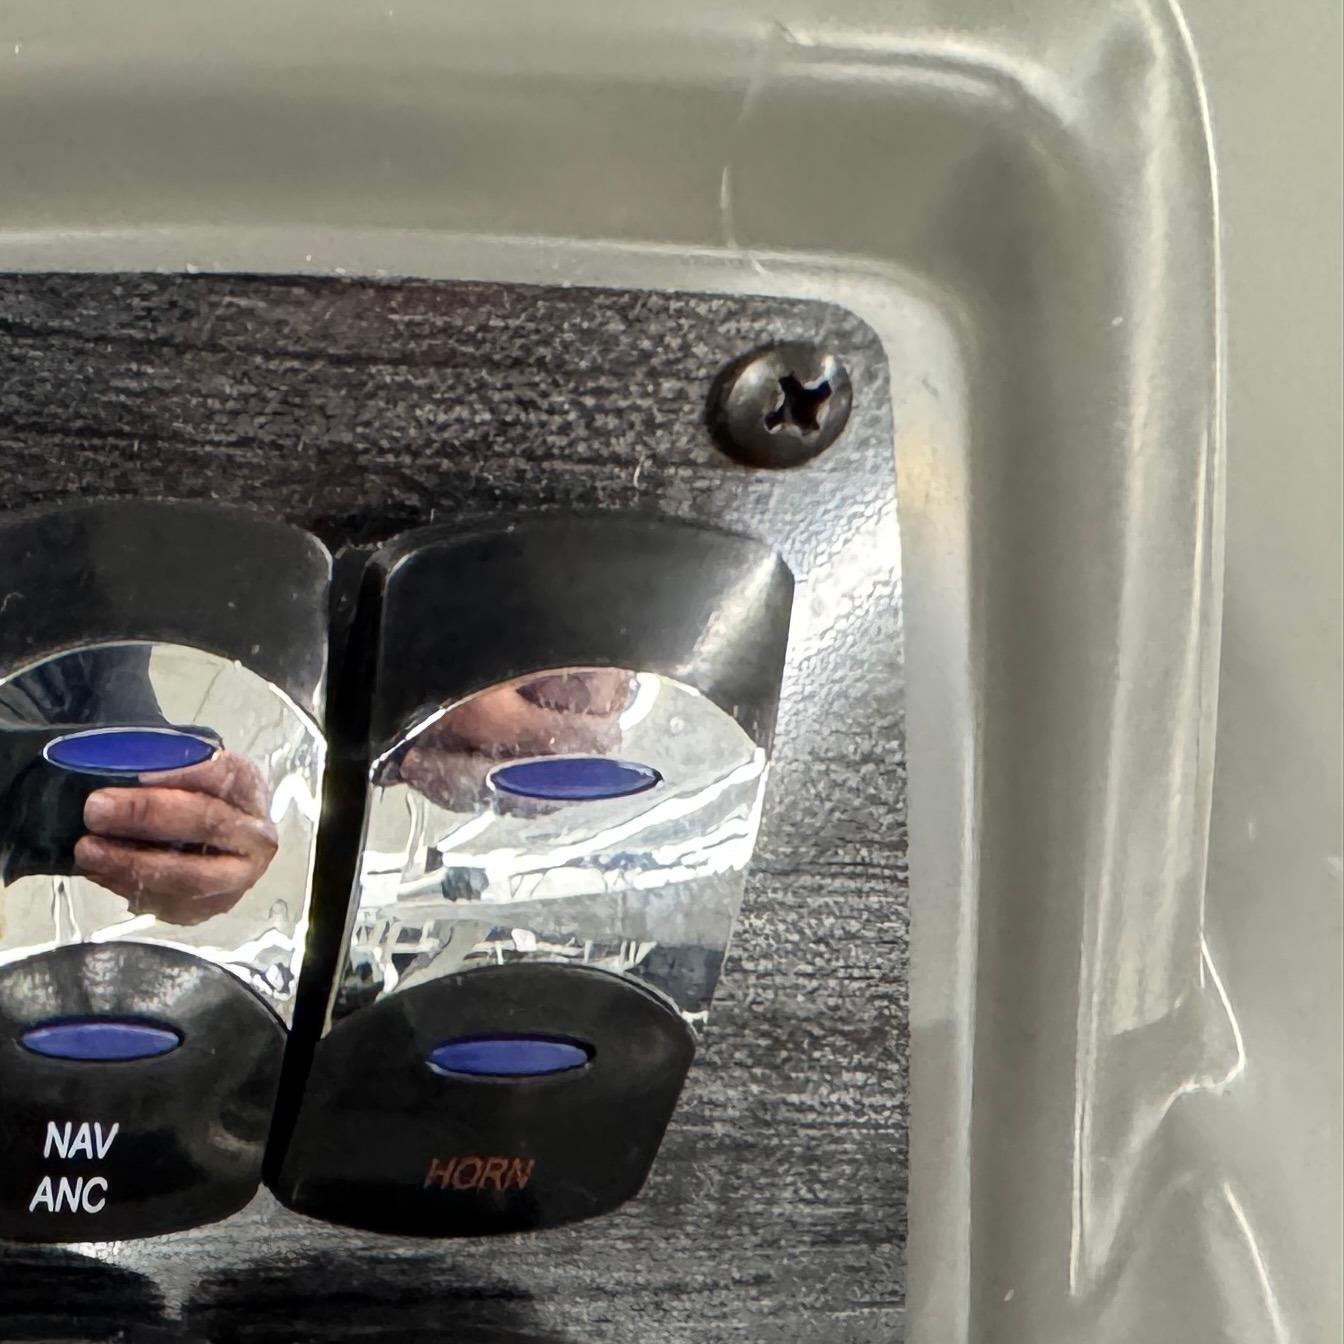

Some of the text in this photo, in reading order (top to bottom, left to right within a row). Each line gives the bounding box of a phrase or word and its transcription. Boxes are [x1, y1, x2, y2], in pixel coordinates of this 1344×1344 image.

[43, 1121, 120, 1160] NAV
[424, 1156, 536, 1191] HORN
[28, 1175, 108, 1214] ANC
